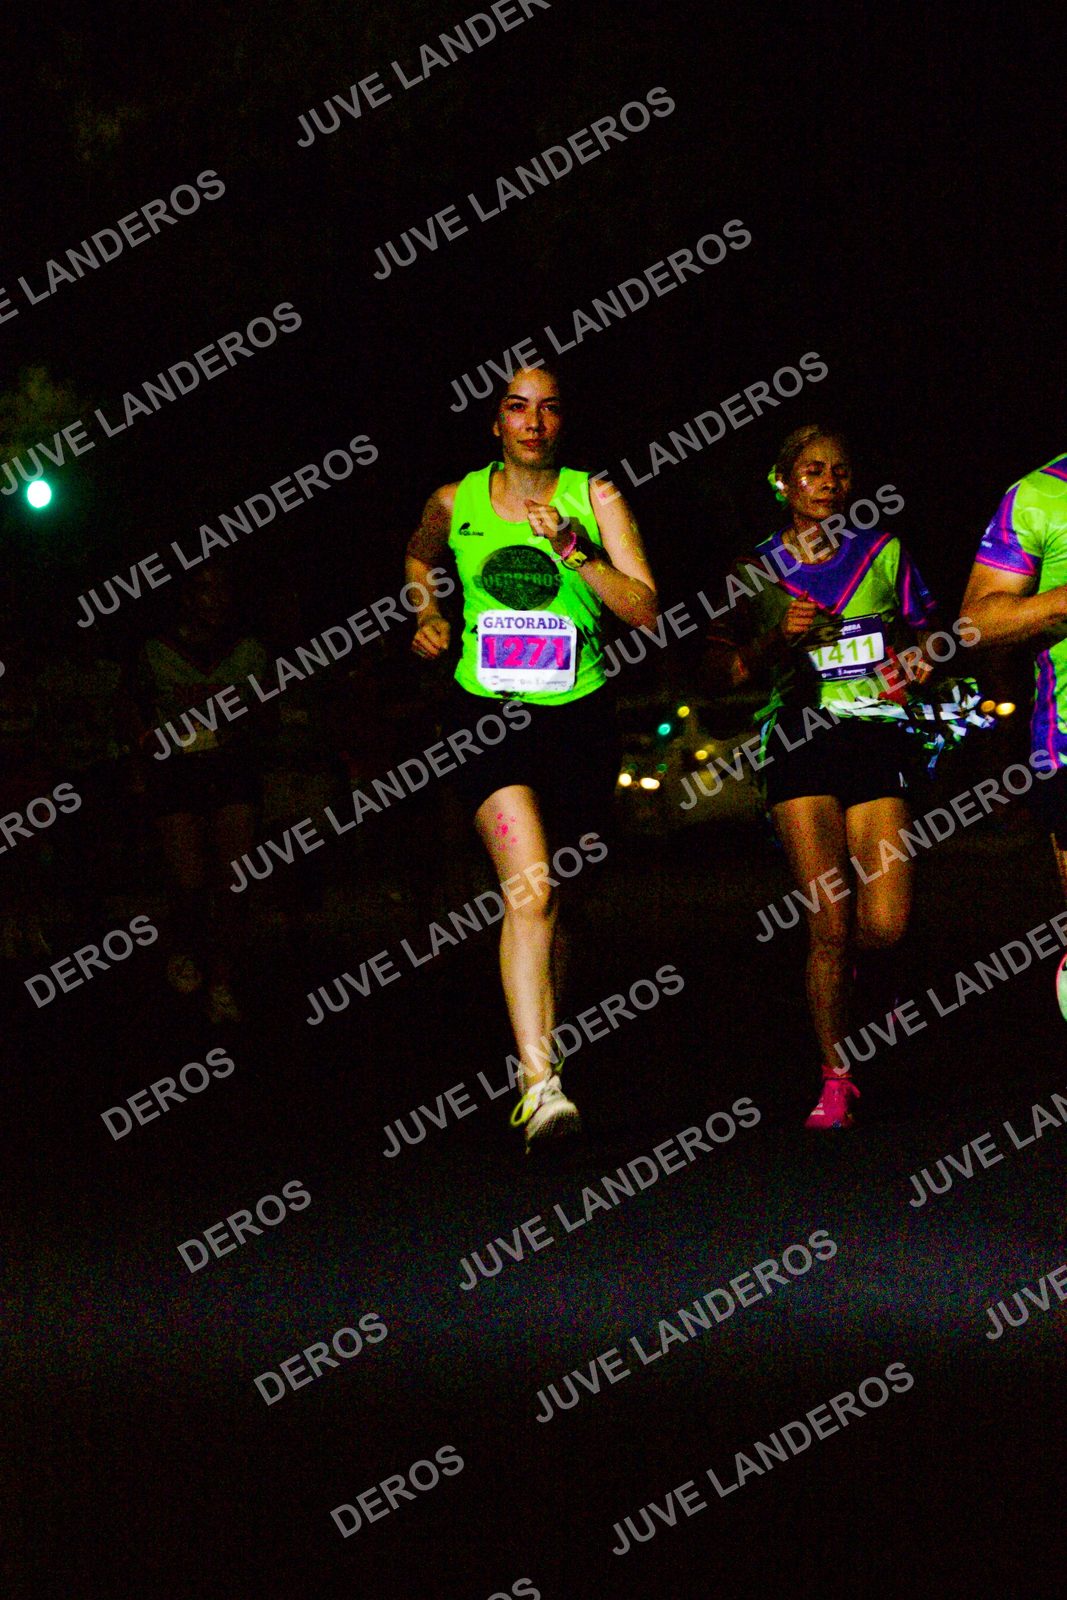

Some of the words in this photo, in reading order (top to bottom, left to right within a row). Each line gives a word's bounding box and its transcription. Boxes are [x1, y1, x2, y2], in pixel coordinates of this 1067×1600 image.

[483, 616, 567, 630] GATORADE
[484, 636, 565, 668] 1271
[812, 635, 875, 667] 1411
